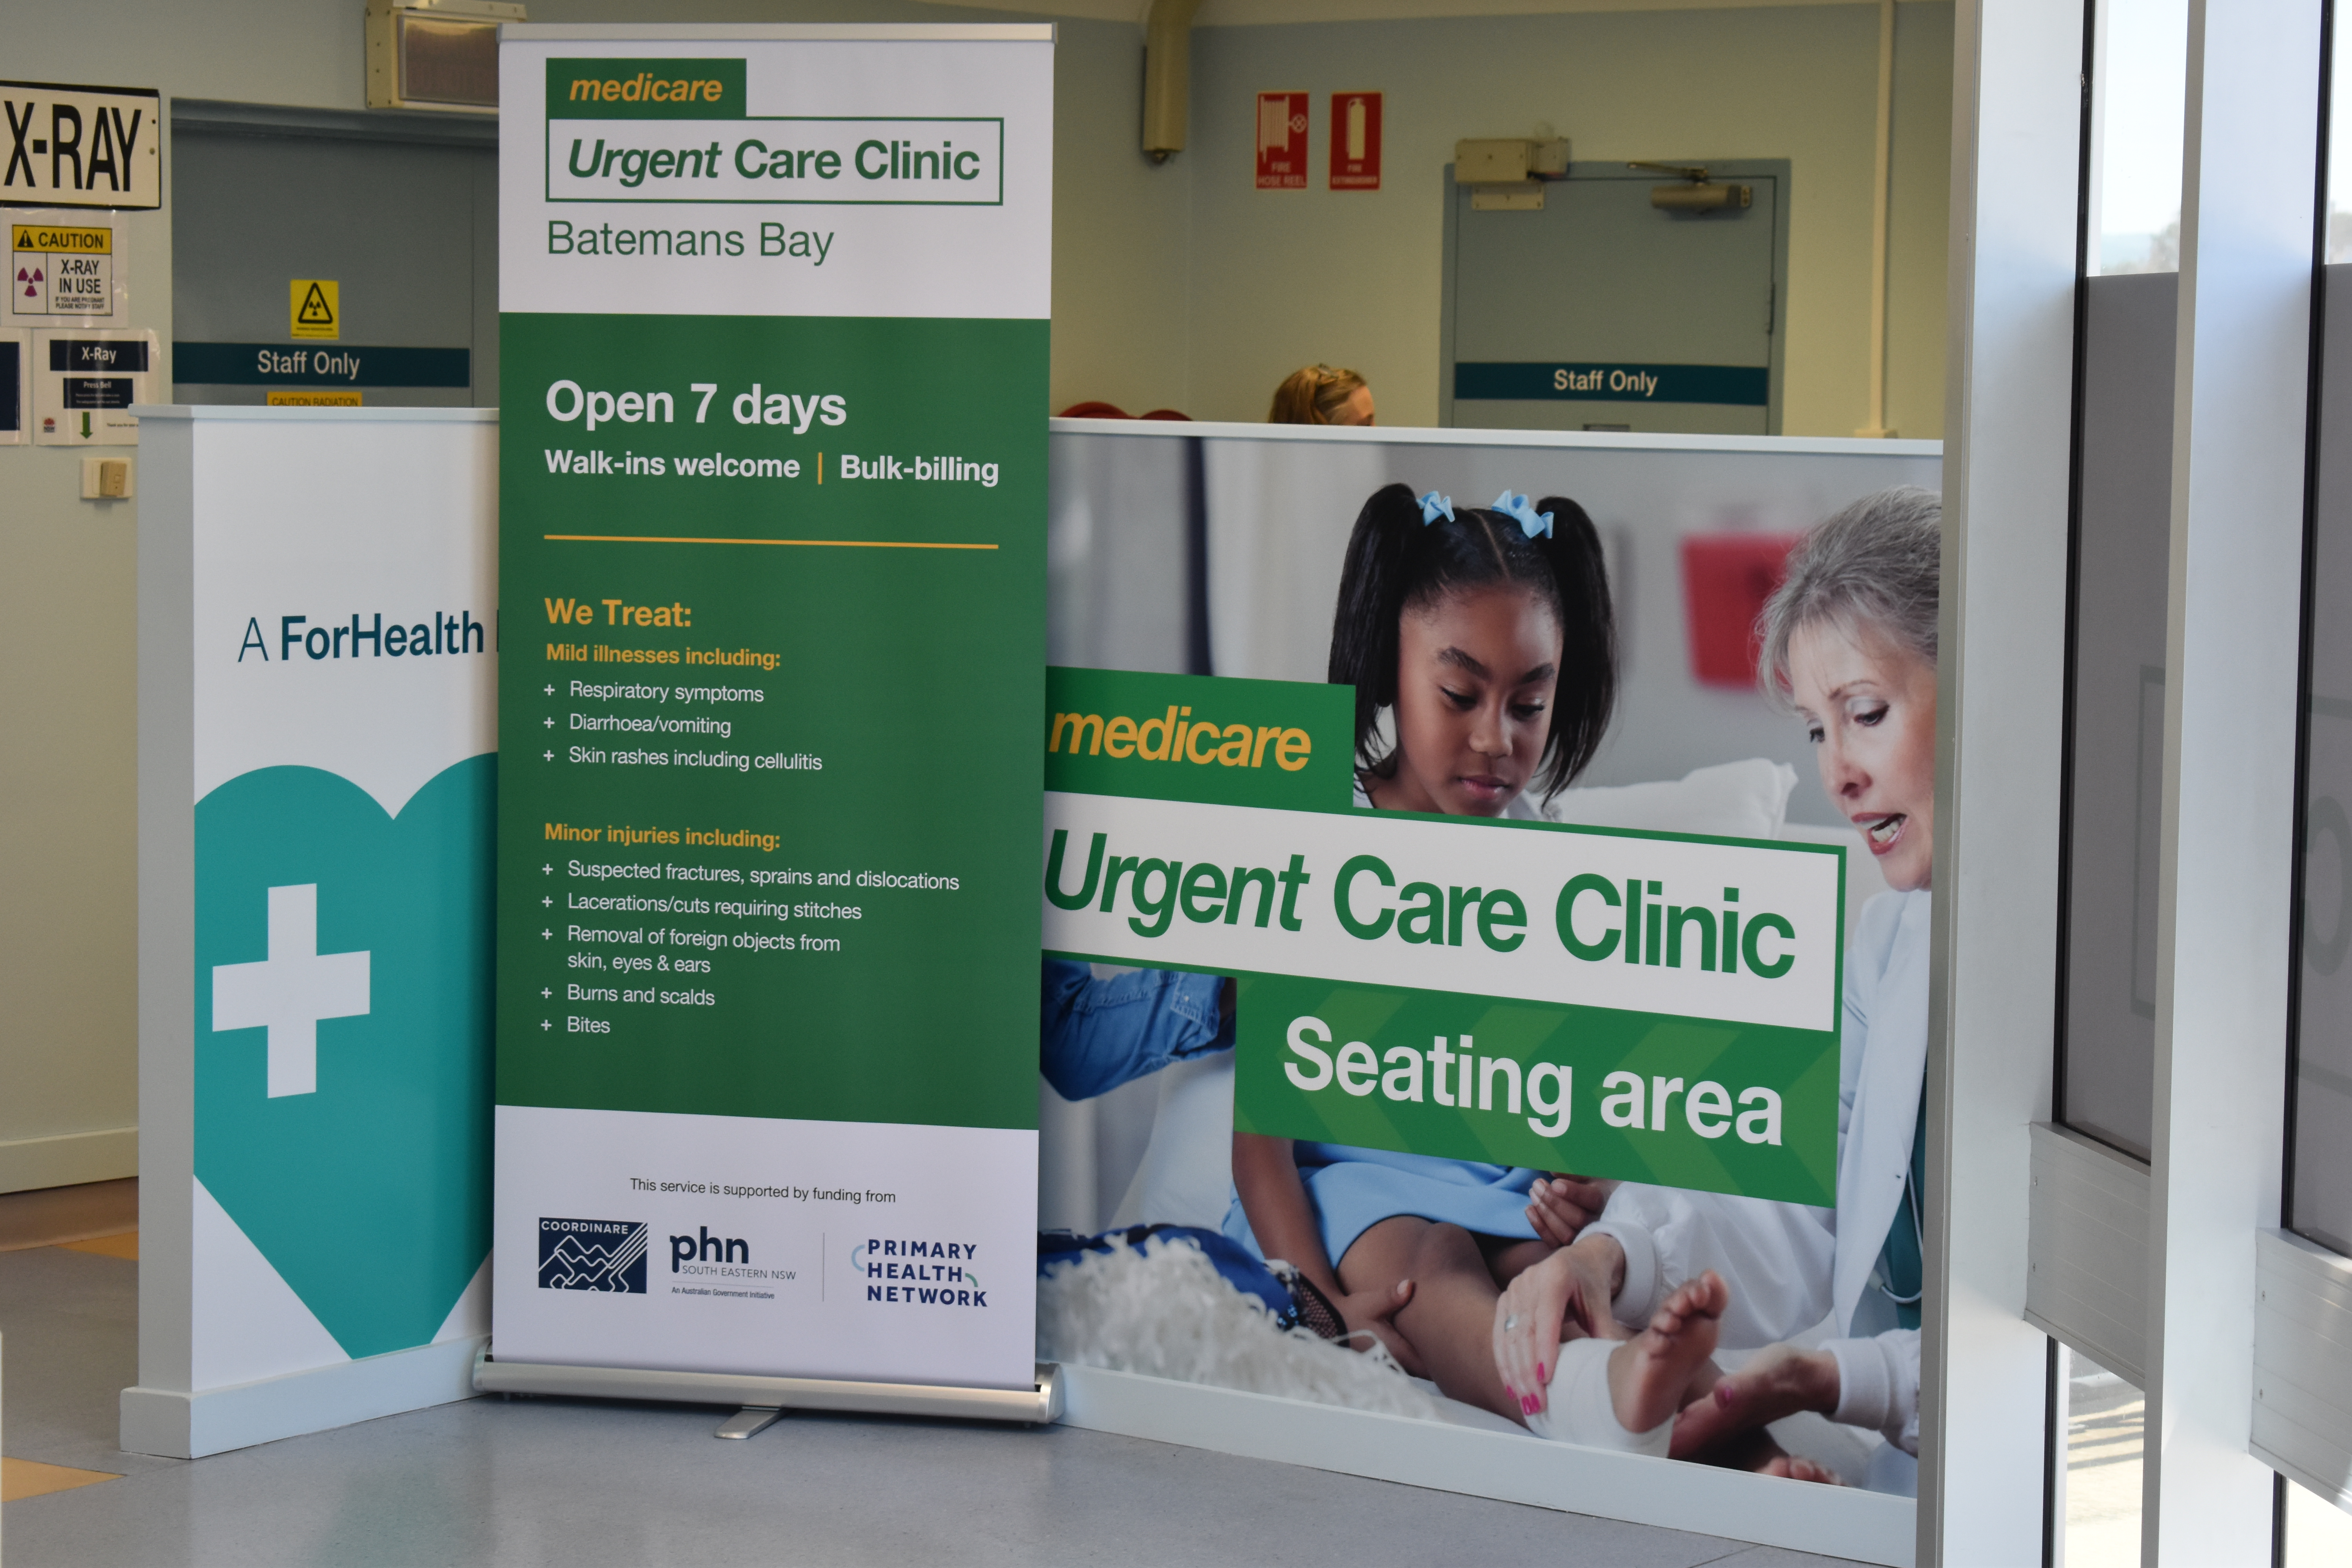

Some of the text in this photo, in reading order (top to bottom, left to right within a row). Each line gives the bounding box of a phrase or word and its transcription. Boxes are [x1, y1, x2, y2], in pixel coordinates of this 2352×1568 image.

[570, 73, 722, 101] medicare
[4, 101, 141, 191] X-RAY
[569, 139, 979, 187] Urgent Care Clinic
[38, 232, 103, 248] CAUTION
[549, 221, 834, 266] Batemans Bay
[61, 260, 99, 275] X-RAY
[60, 278, 100, 294] IN USE
[82, 347, 116, 363] X-Ray
[258, 350, 360, 380] Staff Only
[83, 381, 99, 389] Press
[1554, 369, 1657, 396] Staff Only
[272, 397, 358, 407] CAUTION RADIATION
[546, 380, 846, 434] Open 7 days
[545, 450, 998, 487] Walk-ins welcome Bulk-billing
[545, 598, 691, 626] We Treat:
[238, 617, 269, 662] A
[282, 611, 484, 660] ForHealth
[547, 644, 780, 670] Mild illnesses including:
[571, 681, 764, 704] Respiratory symptoms
[570, 713, 731, 738] Diarrhoea/vomiting
[1049, 706, 1311, 771] medicare
[570, 746, 822, 771] Skin rashes including cellulitis
[545, 823, 780, 852] Minor injuries including:
[568, 860, 959, 890] Suspected fractures, sprains and dislocations
[569, 893, 862, 921] Lacerations/cuts requiring stitches
[1045, 828, 1795, 978] Urgent Care Clinic
[568, 925, 840, 952] Removal of foreign objects from
[568, 952, 710, 973] skin, eyes & ears
[568, 984, 715, 1005] Burns and scalds
[568, 1016, 610, 1033] Bites
[1285, 1016, 1782, 1145] Seating area
[630, 1178, 895, 1204] This service is supported by funding from
[541, 1221, 629, 1235] COORDINARE
[670, 1226, 748, 1273] phn
[869, 1240, 976, 1259] PRIMARY
[683, 1266, 717, 1274] SOUTH
[722, 1269, 766, 1278] EASTERN
[868, 1263, 962, 1282] HEALTH
[713, 1289, 748, 1298] Government
[868, 1285, 987, 1307] NETWORK
